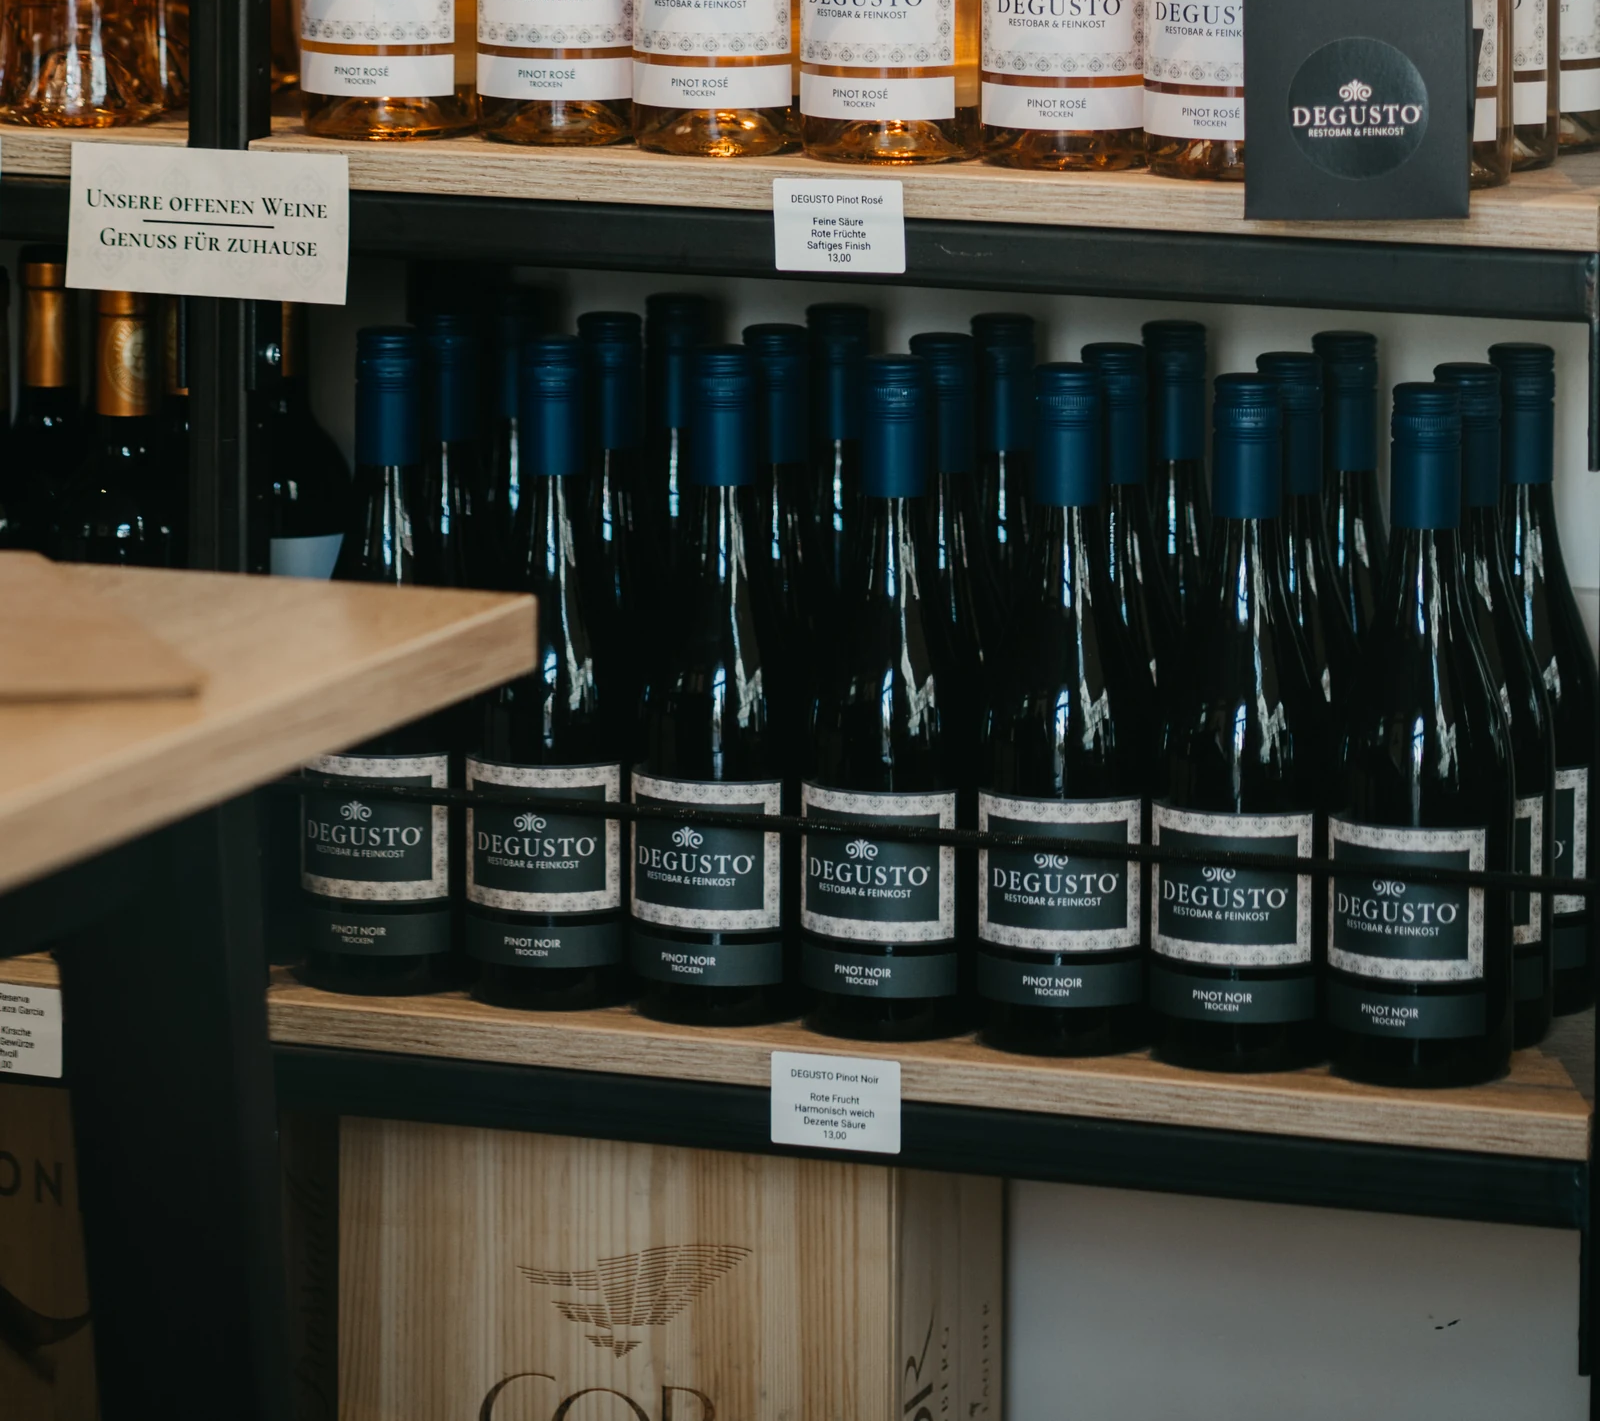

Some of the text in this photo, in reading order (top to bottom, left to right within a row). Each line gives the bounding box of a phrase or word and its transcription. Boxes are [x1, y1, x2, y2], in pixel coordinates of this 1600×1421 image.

[1156, 1, 1243, 25] DEGUS
[1008, 18, 1105, 29] RESTOBAR & FEINKOST
[334, 65, 389, 77] PINOT ROSÉ
[671, 77, 729, 88] PINOT ROSÉ
[832, 88, 888, 100] PINOT ROSÉ
[1027, 97, 1087, 109] PINOT ROSÉ
[1038, 110, 1073, 118] TROCKEN
[1182, 107, 1241, 119] PINOT ROSÉ
[1293, 105, 1421, 127] DEGUSTO
[1308, 126, 1405, 138] RESTOBAR & FEINKOST
[791, 194, 883, 205] DEGUSTO Pinot Rosé
[813, 217, 864, 227] Feine Säure
[811, 229, 866, 239] Rote Früchte
[807, 241, 871, 252] Saftiges Finish
[828, 253, 851, 263] 13,00
[307, 819, 421, 847] DEGUSTO
[477, 831, 595, 858] DEGUSTO
[639, 845, 753, 875] DEGUSTO
[810, 857, 929, 887] DEGUSTO
[993, 868, 1117, 894] DEGUSTO
[1004, 893, 1102, 907] RESTOBAR & FEINKOST
[1163, 880, 1287, 909] DEGUSTO
[1338, 892, 1457, 924] DEGUSTO
[504, 936, 561, 949] PINOT NOIR
[834, 964, 892, 978] PINOT NOIR
[1022, 975, 1082, 988] PINOT NOIR
[1034, 988, 1070, 997] TROCKEN
[1192, 989, 1252, 1004] PINOT NOIR
[1361, 1003, 1419, 1019] PINOT NOIR
[791, 1068, 879, 1084] DEGUSTO Pinot Noir
[810, 1092, 860, 1105] Rote Frucht
[794, 1104, 875, 1119] Harmonisch weich
[803, 1116, 866, 1130] Dezente Säure
[823, 1130, 847, 1140] 13,00
